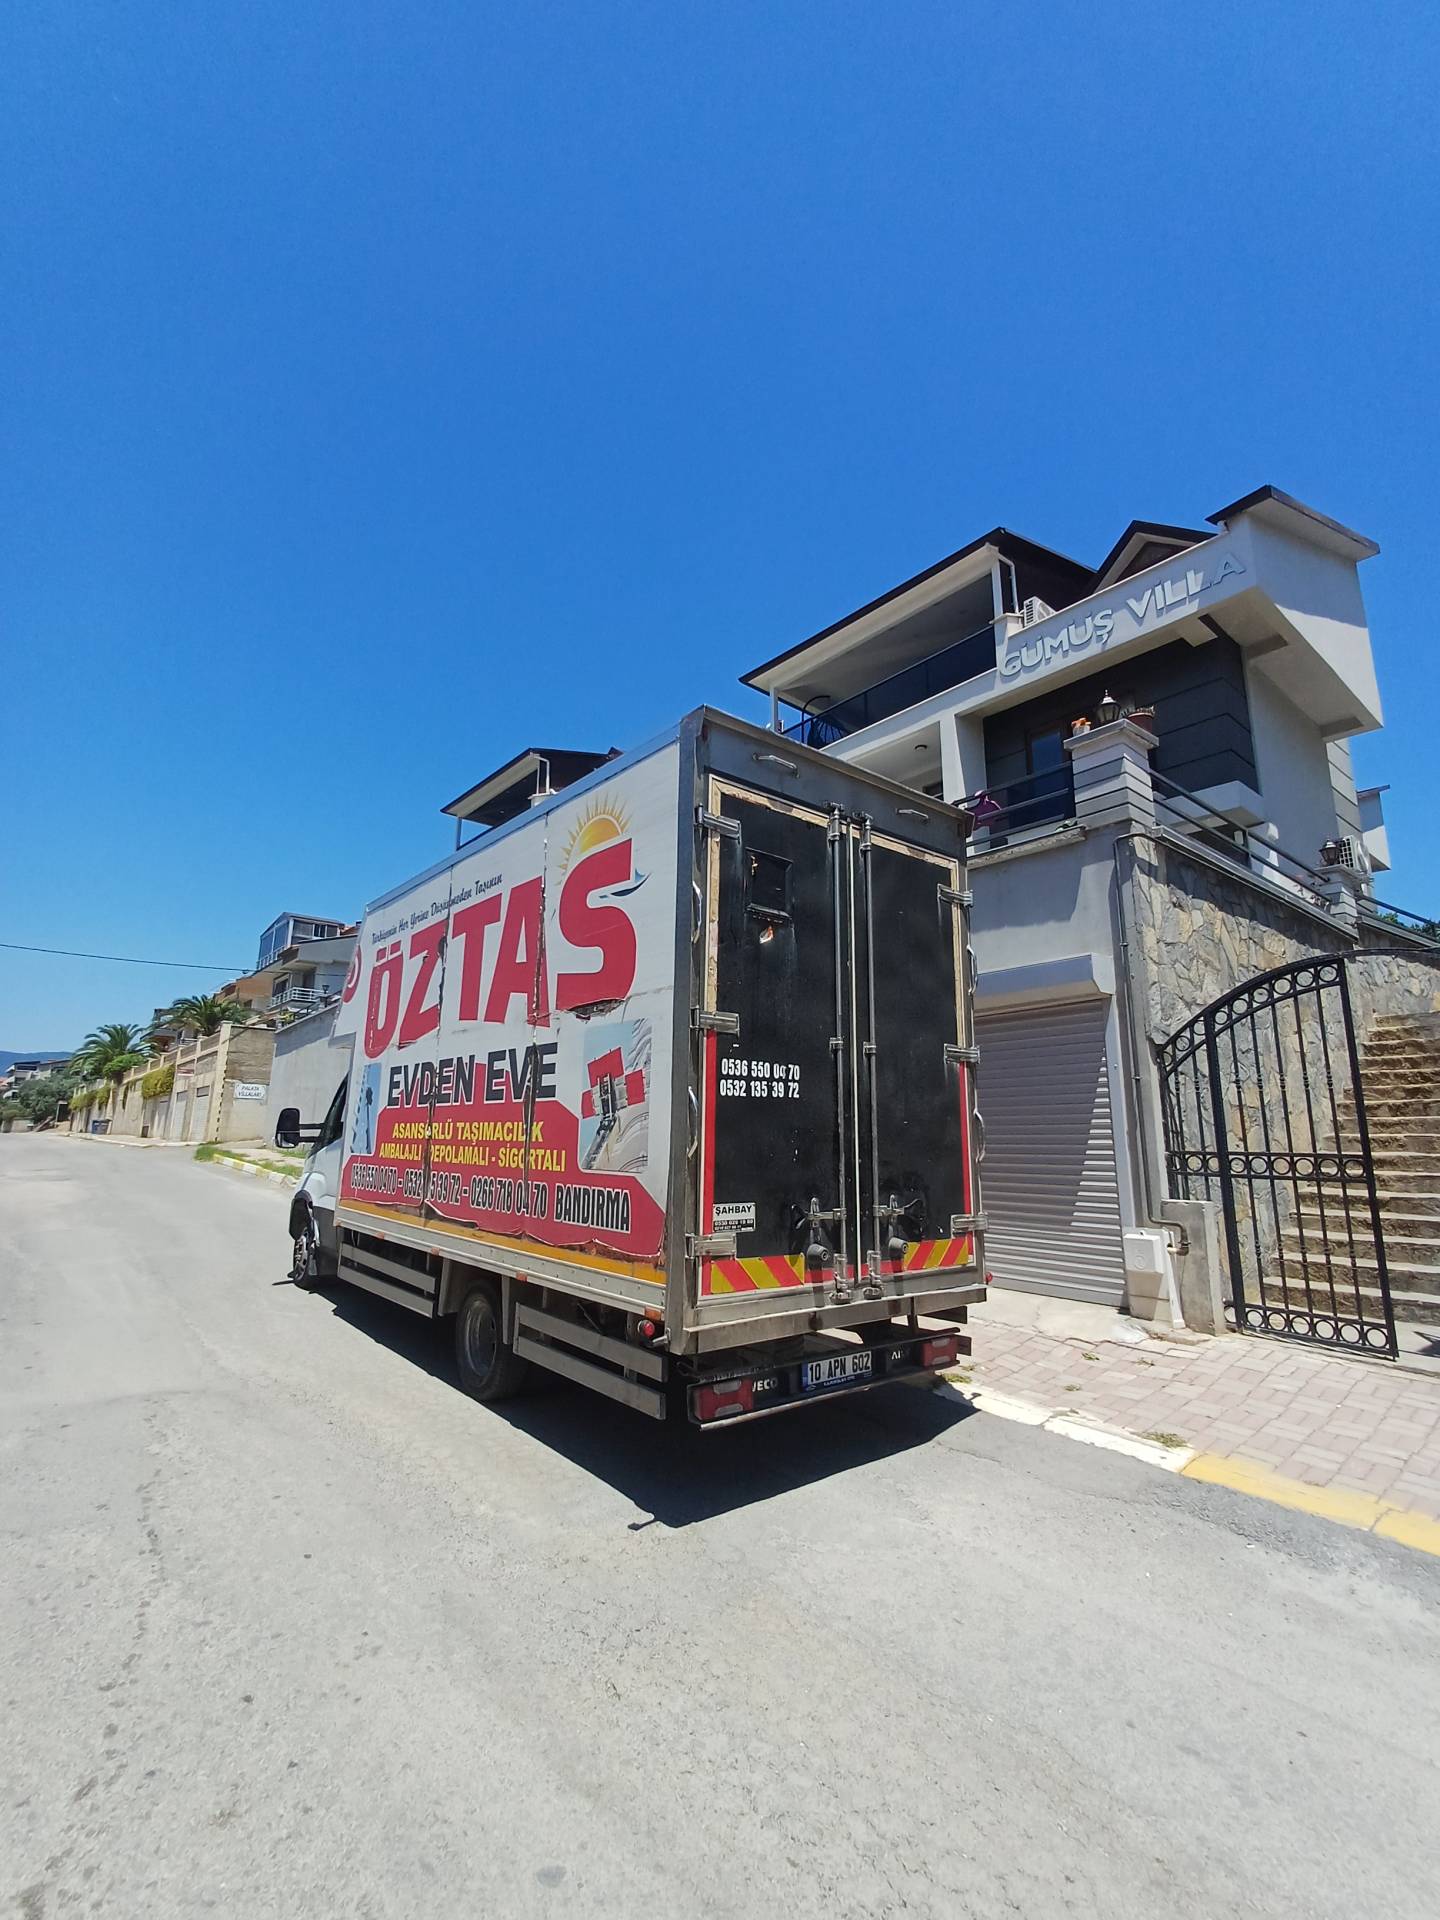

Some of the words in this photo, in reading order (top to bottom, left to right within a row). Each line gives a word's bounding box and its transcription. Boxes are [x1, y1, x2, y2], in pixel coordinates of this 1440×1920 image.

[399, 918, 409, 933] Her
[475, 874, 503, 896] Taşının
[387, 1054, 476, 1107] EVDEN
[485, 1042, 559, 1102] EVE
[721, 1058, 748, 1077] 0536
[751, 1060, 771, 1078] 550
[788, 1064, 800, 1081] 70
[719, 1079, 747, 1097] 0532
[750, 1080, 768, 1098] 135
[771, 1081, 785, 1098] 39
[787, 1081, 800, 1099] 72
[457, 1120, 545, 1147] TAŞIMACILK
[379, 1142, 422, 1161] AMBALAJLI
[437, 1172, 449, 1204] 39
[449, 1173, 462, 1206] 72
[470, 1175, 495, 1211] 0266
[495, 1177, 515, 1214] 718
[532, 1181, 549, 1220] 70
[554, 1183, 632, 1234] BANDIRMA
[715, 1205, 752, 1217] ŞAHBAY
[810, 1363, 821, 1383] 10
[827, 1357, 847, 1379] APN
[852, 1353, 871, 1373] 602
